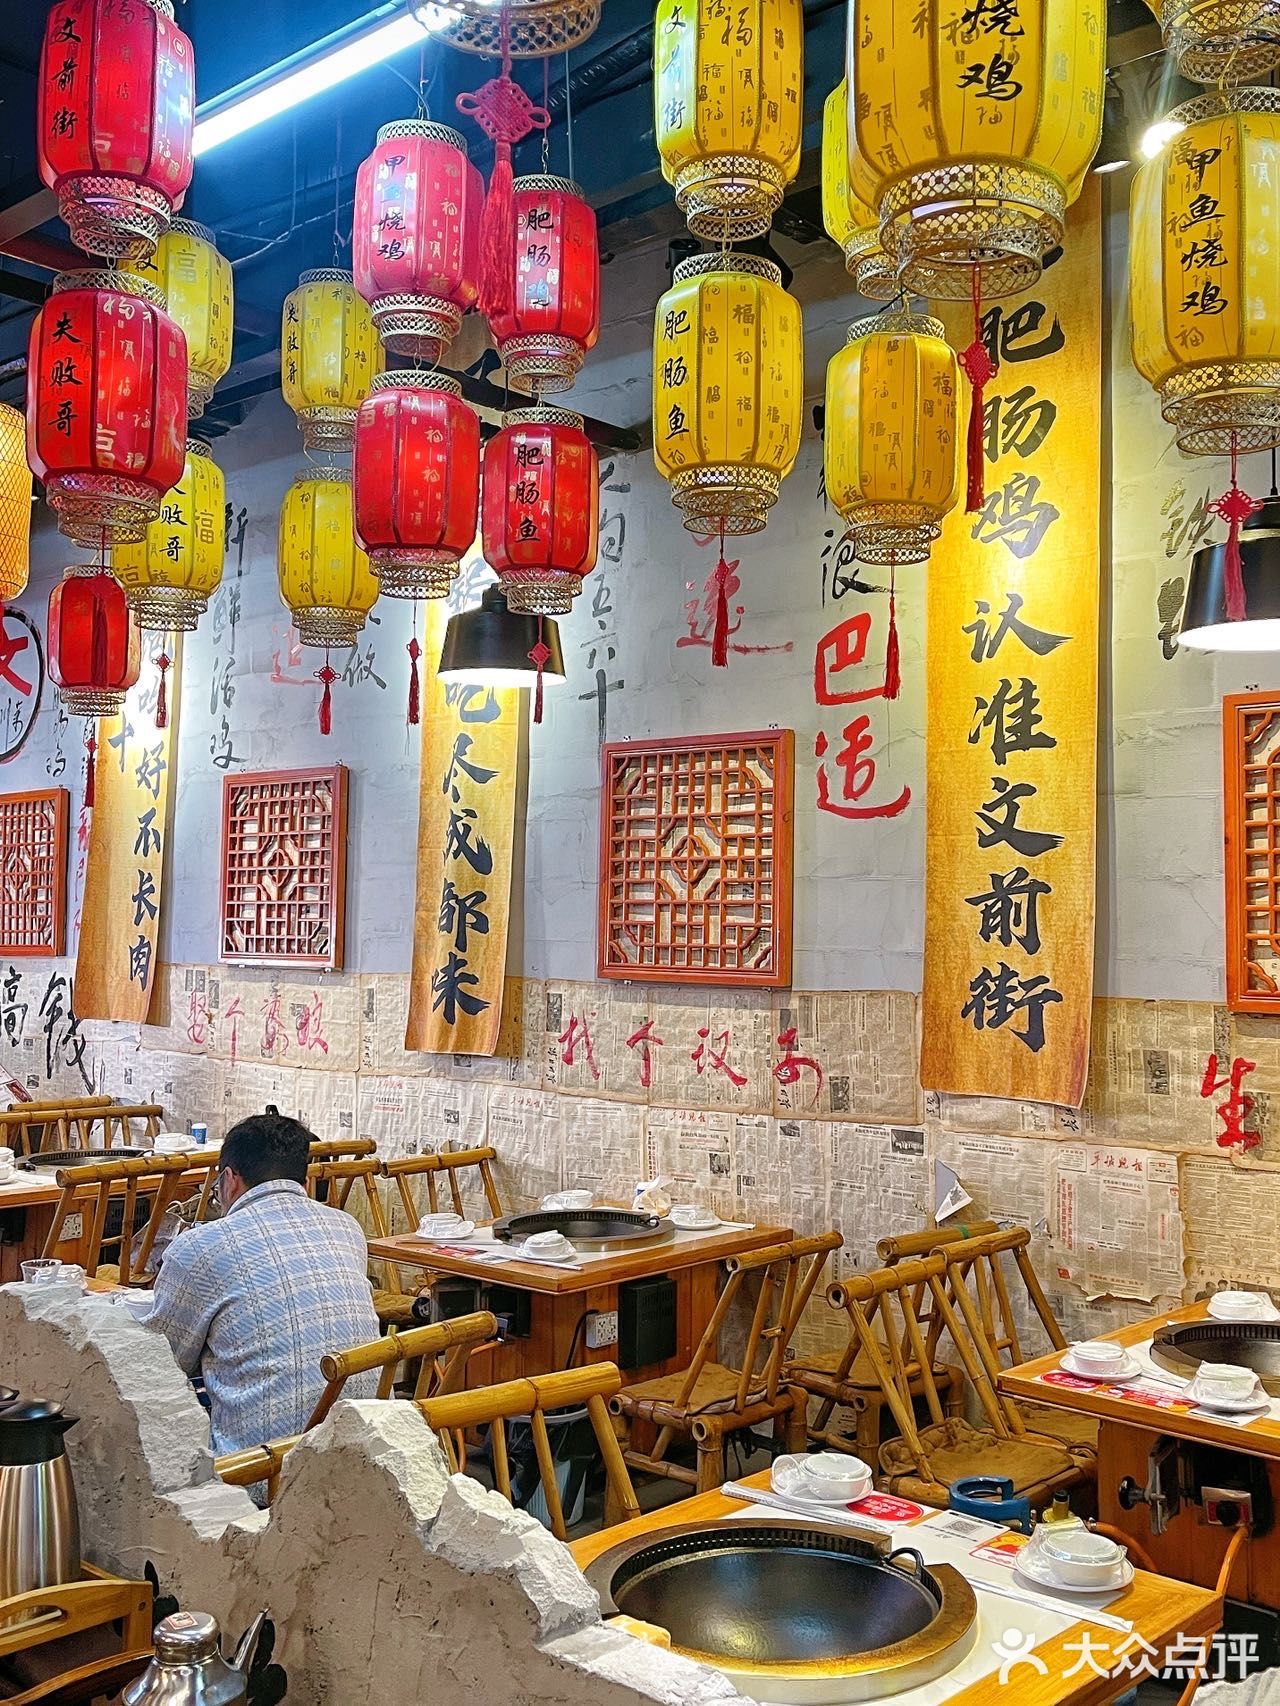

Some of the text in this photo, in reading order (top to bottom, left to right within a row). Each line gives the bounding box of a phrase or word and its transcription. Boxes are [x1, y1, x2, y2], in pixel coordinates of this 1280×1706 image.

[51, 16, 82, 141] 文前街
[662, 5, 687, 132] 文前街
[1179, 148, 1229, 316] 甲鱼烧鸡
[662, 309, 691, 441] 肥肠鱼
[160, 486, 189, 562] 败哥
[514, 444, 544, 544] 肥肠鱼
[814, 612, 912, 820] 巴适
[961, 300, 1074, 1052] 肥肠鸡认准文前街
